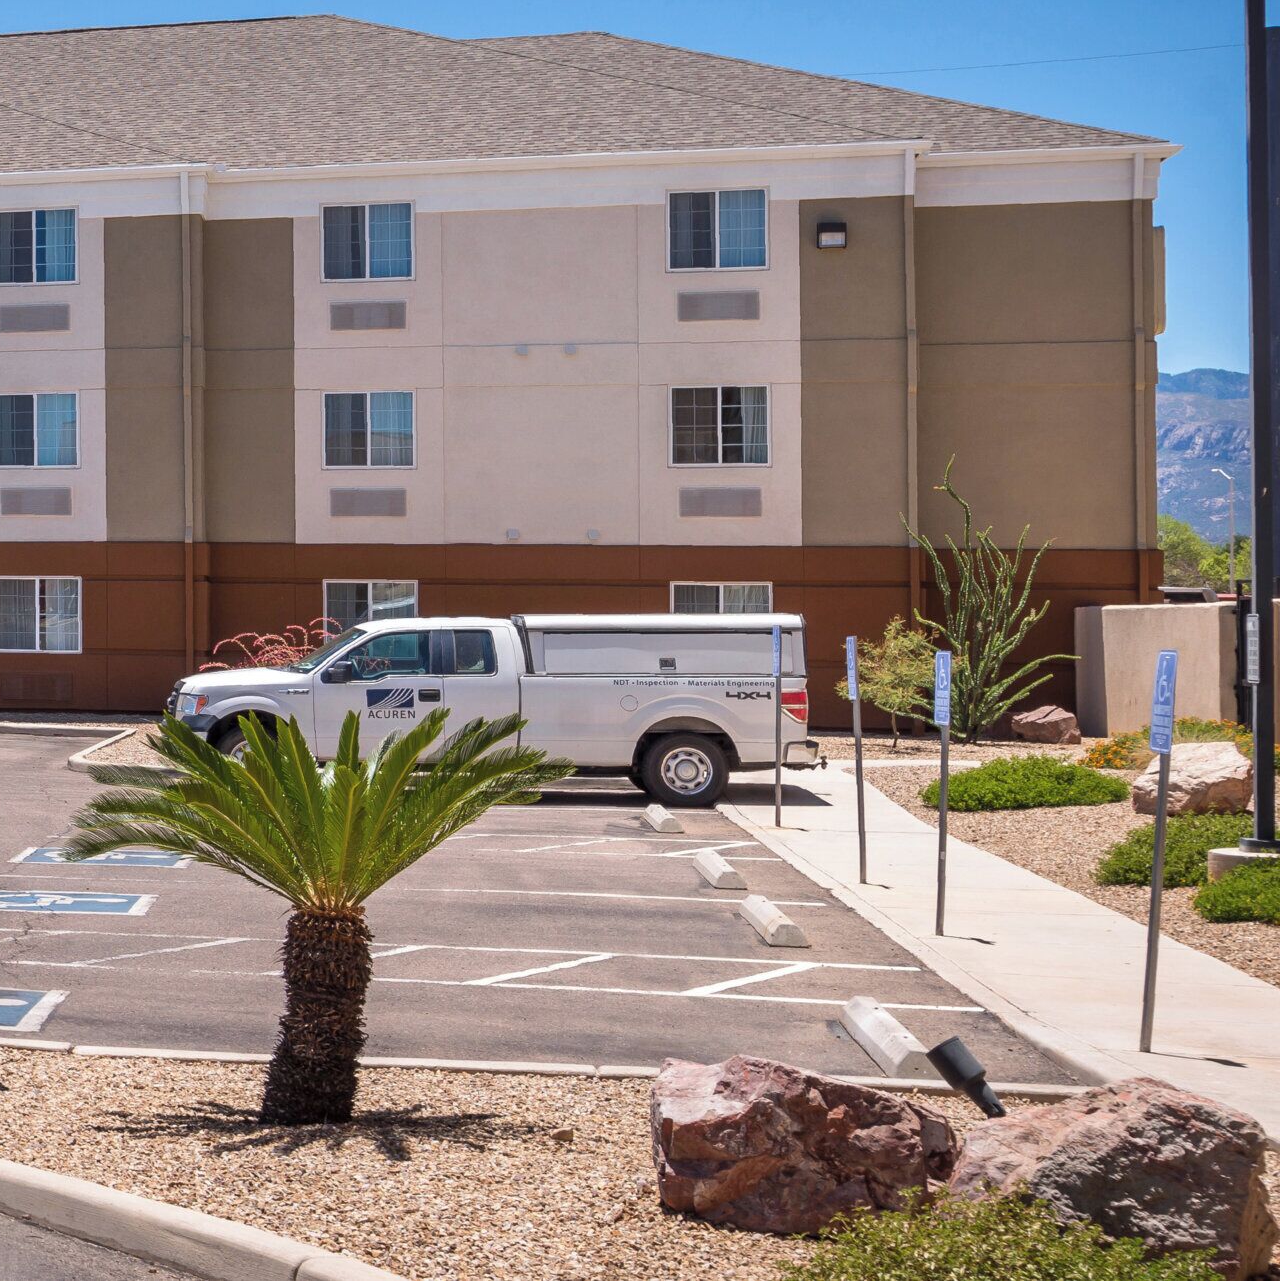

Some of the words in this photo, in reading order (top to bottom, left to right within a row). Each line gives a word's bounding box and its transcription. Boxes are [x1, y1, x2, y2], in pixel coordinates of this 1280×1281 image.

[636, 679, 679, 687] Inspection
[687, 679, 725, 687] Materials
[726, 679, 775, 688] Engineering
[367, 709, 416, 719] ACUREN
